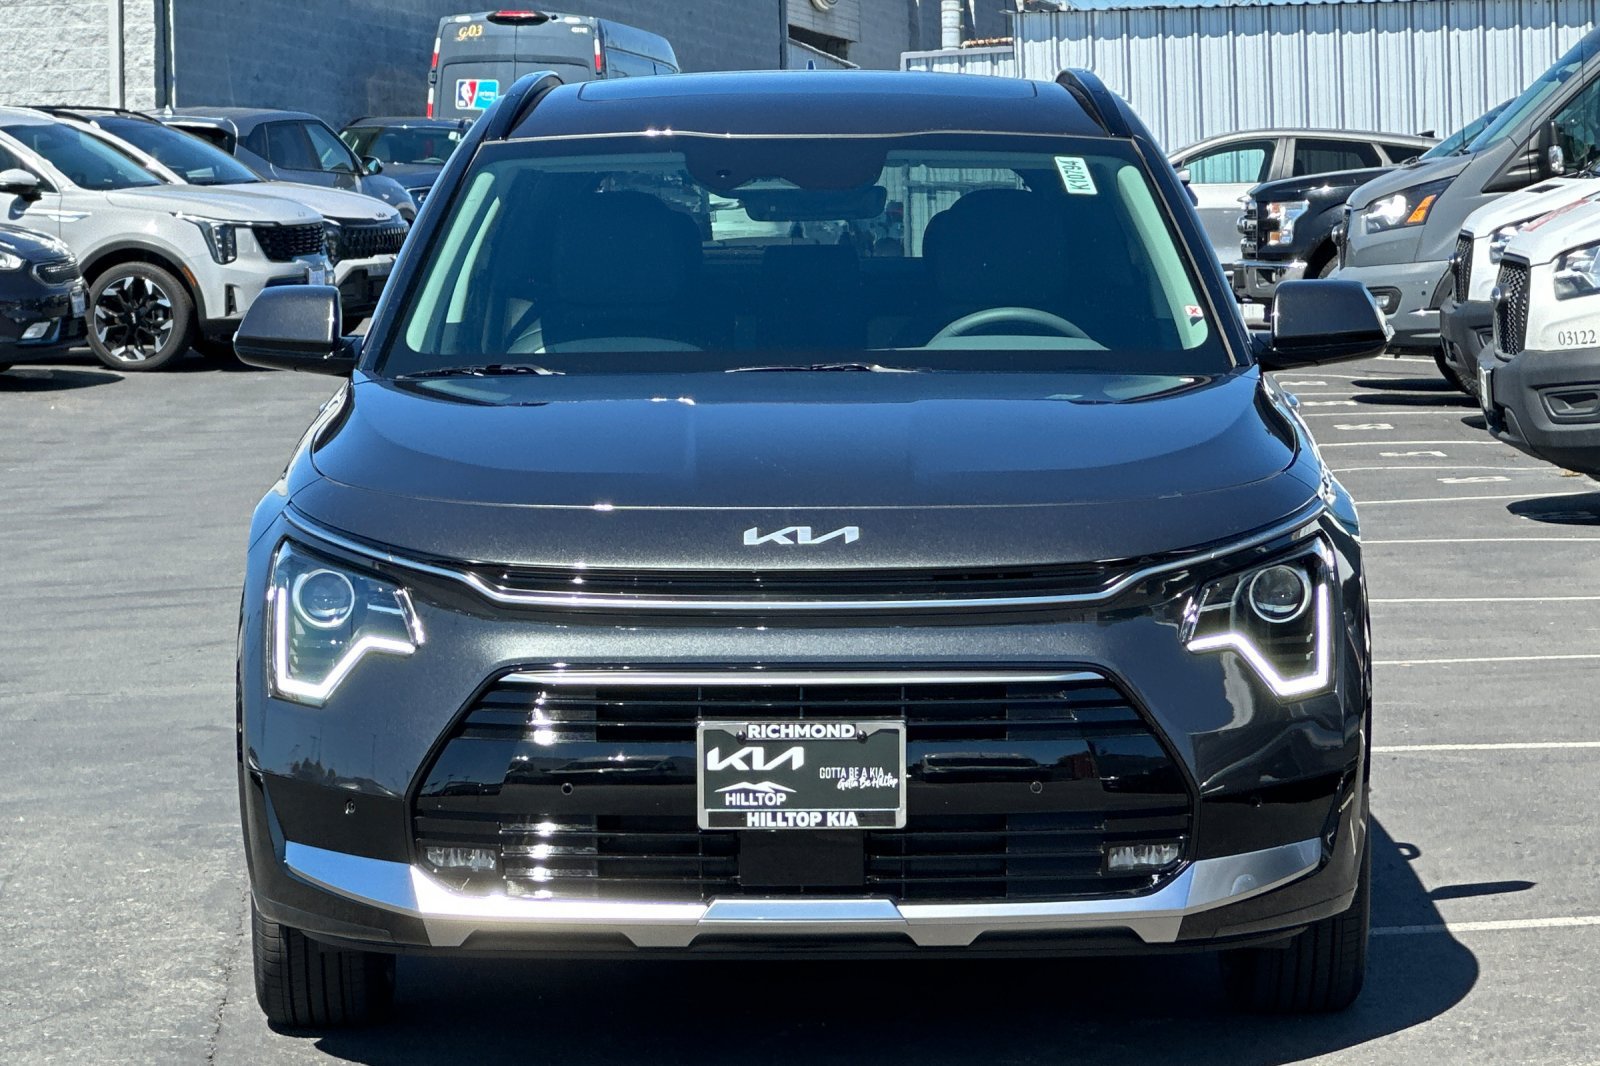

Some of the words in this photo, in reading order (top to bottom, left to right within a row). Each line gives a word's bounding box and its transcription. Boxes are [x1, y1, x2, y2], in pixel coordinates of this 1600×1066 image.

[1558, 330, 1596, 345] 03122
[743, 526, 859, 545] KIA
[747, 724, 855, 738] RICHMOND
[707, 746, 804, 771] KIA
[819, 767, 847, 779] GOTTA
[848, 767, 859, 779] BE
[861, 767, 868, 778] A
[869, 767, 884, 778] KIA
[725, 792, 787, 806] HILLTOP
[746, 811, 822, 827] HILLTOP
[827, 811, 859, 827] KIA
